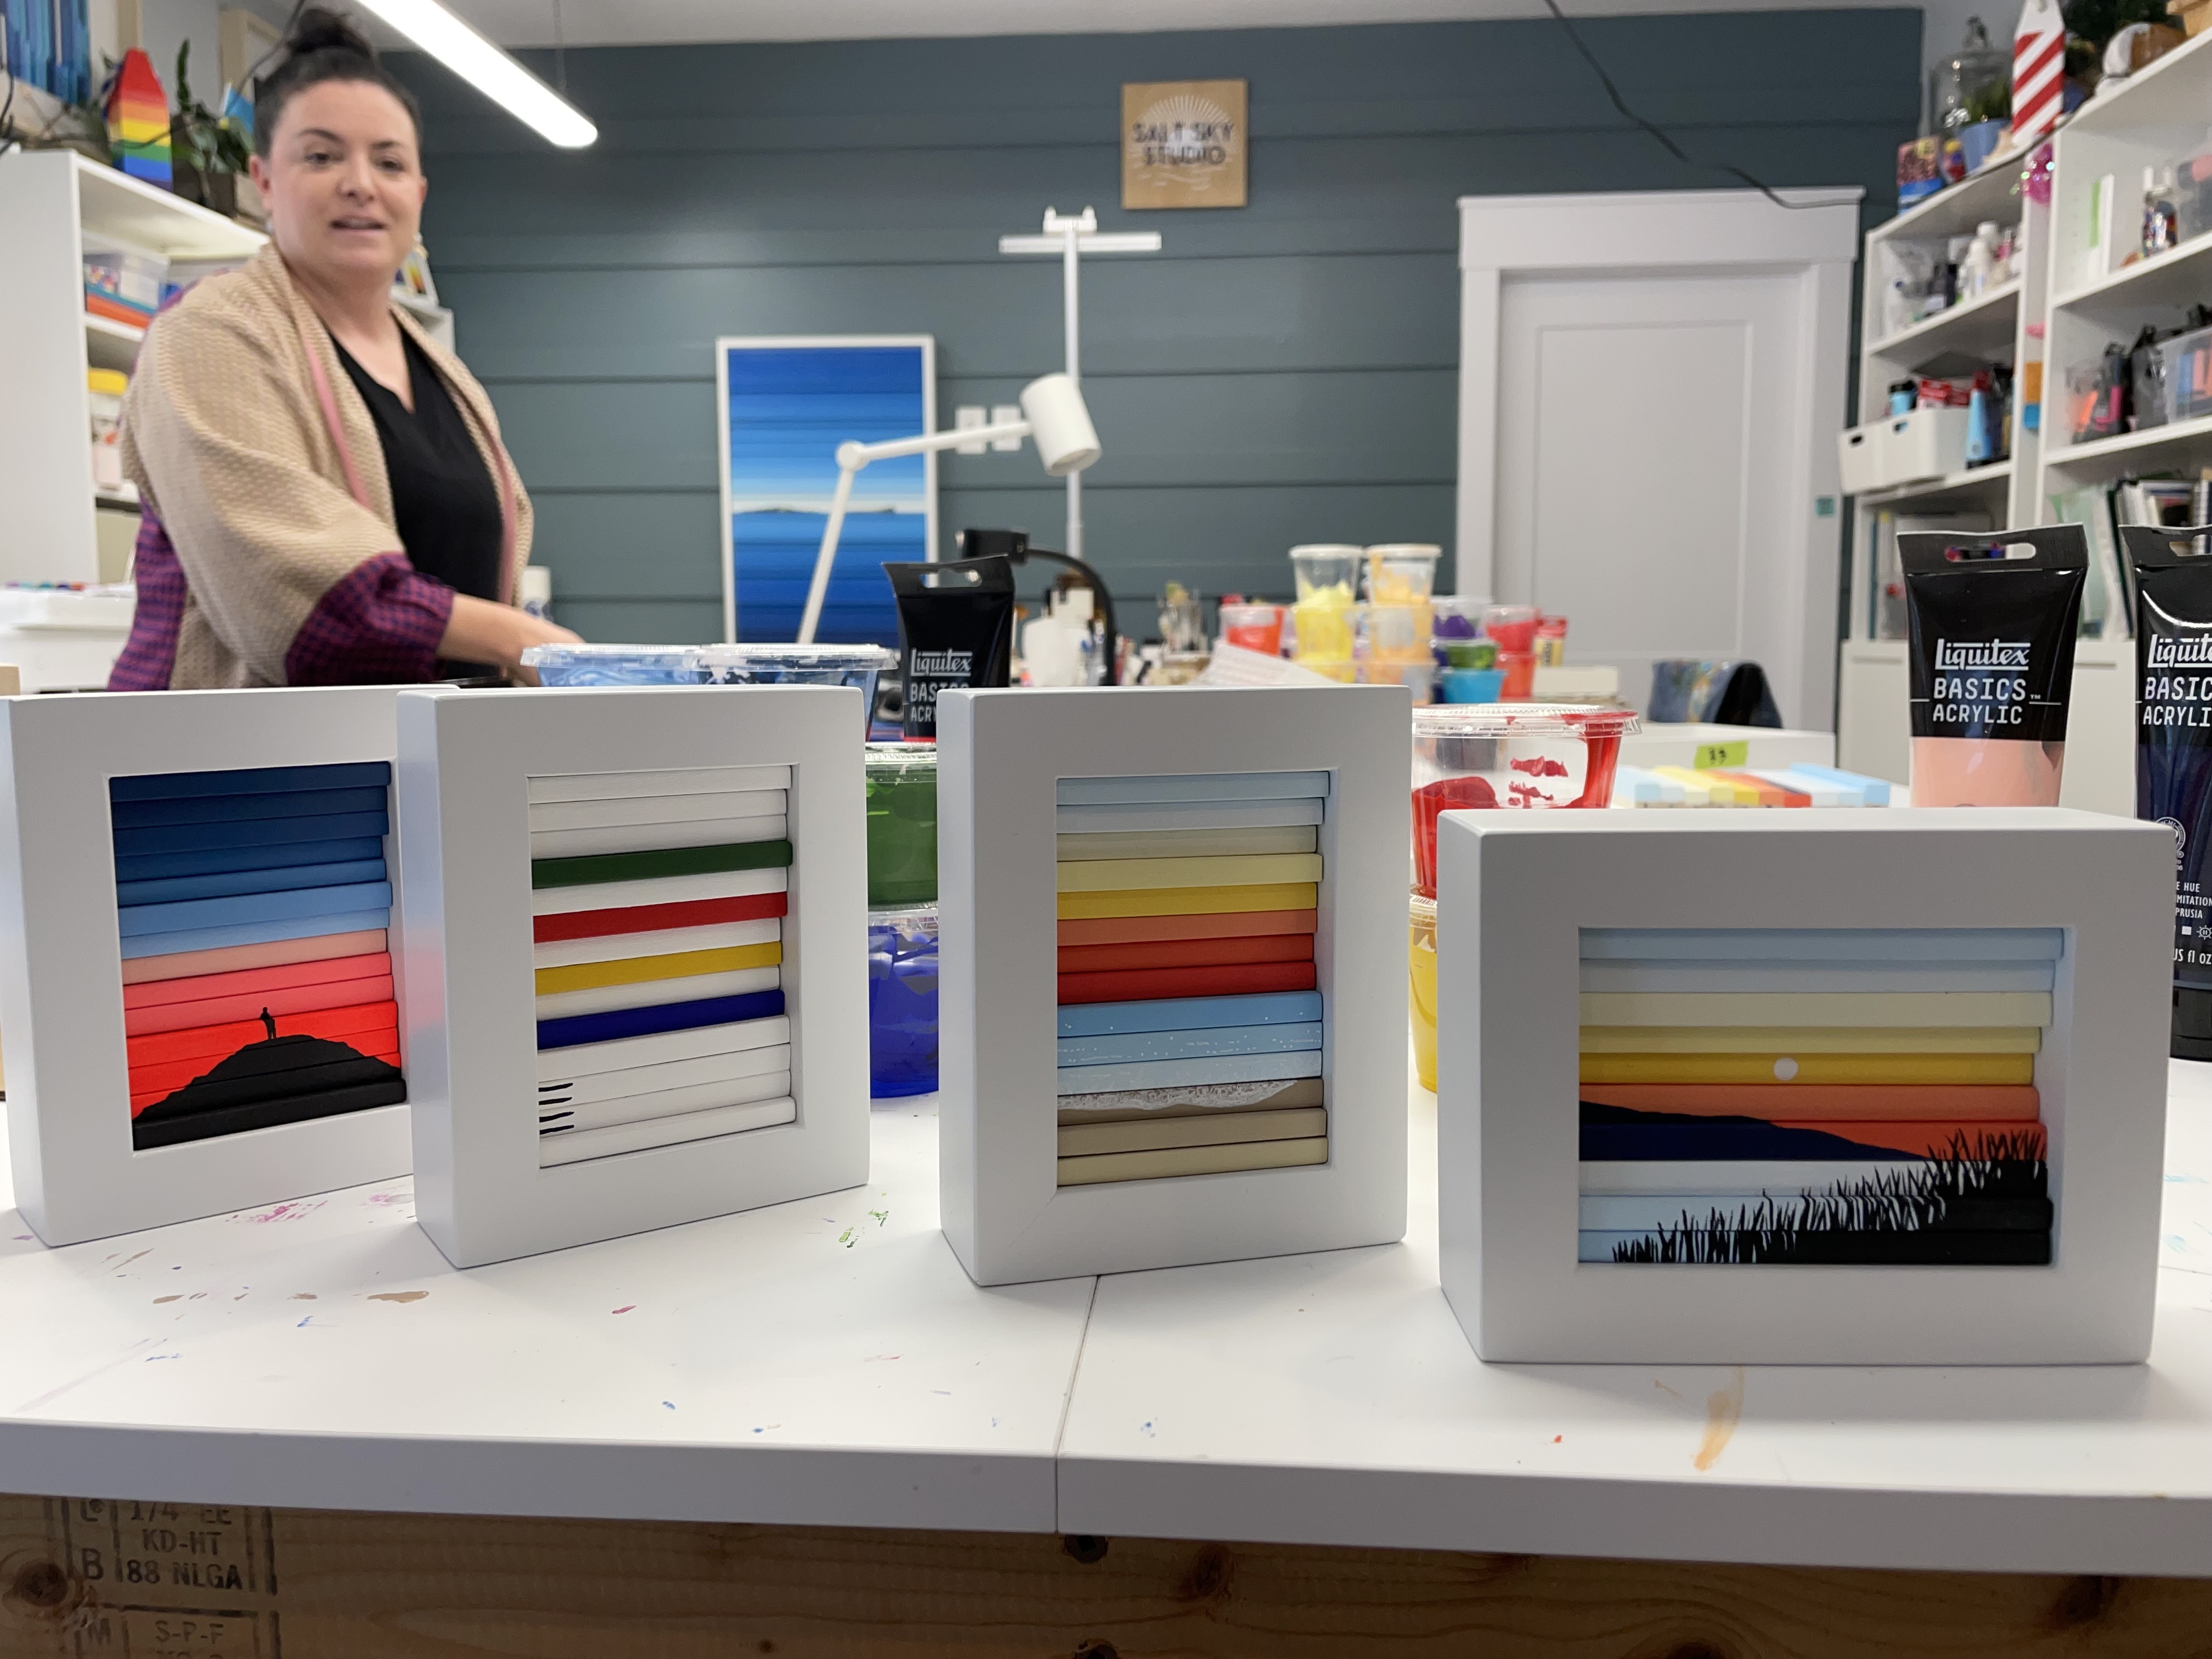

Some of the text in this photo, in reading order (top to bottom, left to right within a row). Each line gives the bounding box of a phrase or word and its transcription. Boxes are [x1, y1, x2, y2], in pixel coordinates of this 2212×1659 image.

[1192, 121, 1234, 142] SKY
[1143, 145, 1227, 165] STUDIO
[911, 647, 973, 676] Liquitex
[1935, 638, 2031, 670] Liquitex
[911, 681, 970, 702] BAS
[1933, 678, 2027, 701] BASICS
[1932, 703, 2023, 725] ACRYLIC
[2183, 882, 2200, 893] HUE
[2175, 907, 2203, 919] PRUSIA
[2187, 950, 2196, 963] fl
[142, 1528, 223, 1555] KD-HT
[82, 1548, 104, 1580] B
[126, 1559, 242, 1590] 88 NLGA
[155, 1620, 224, 1645] S-P-F
